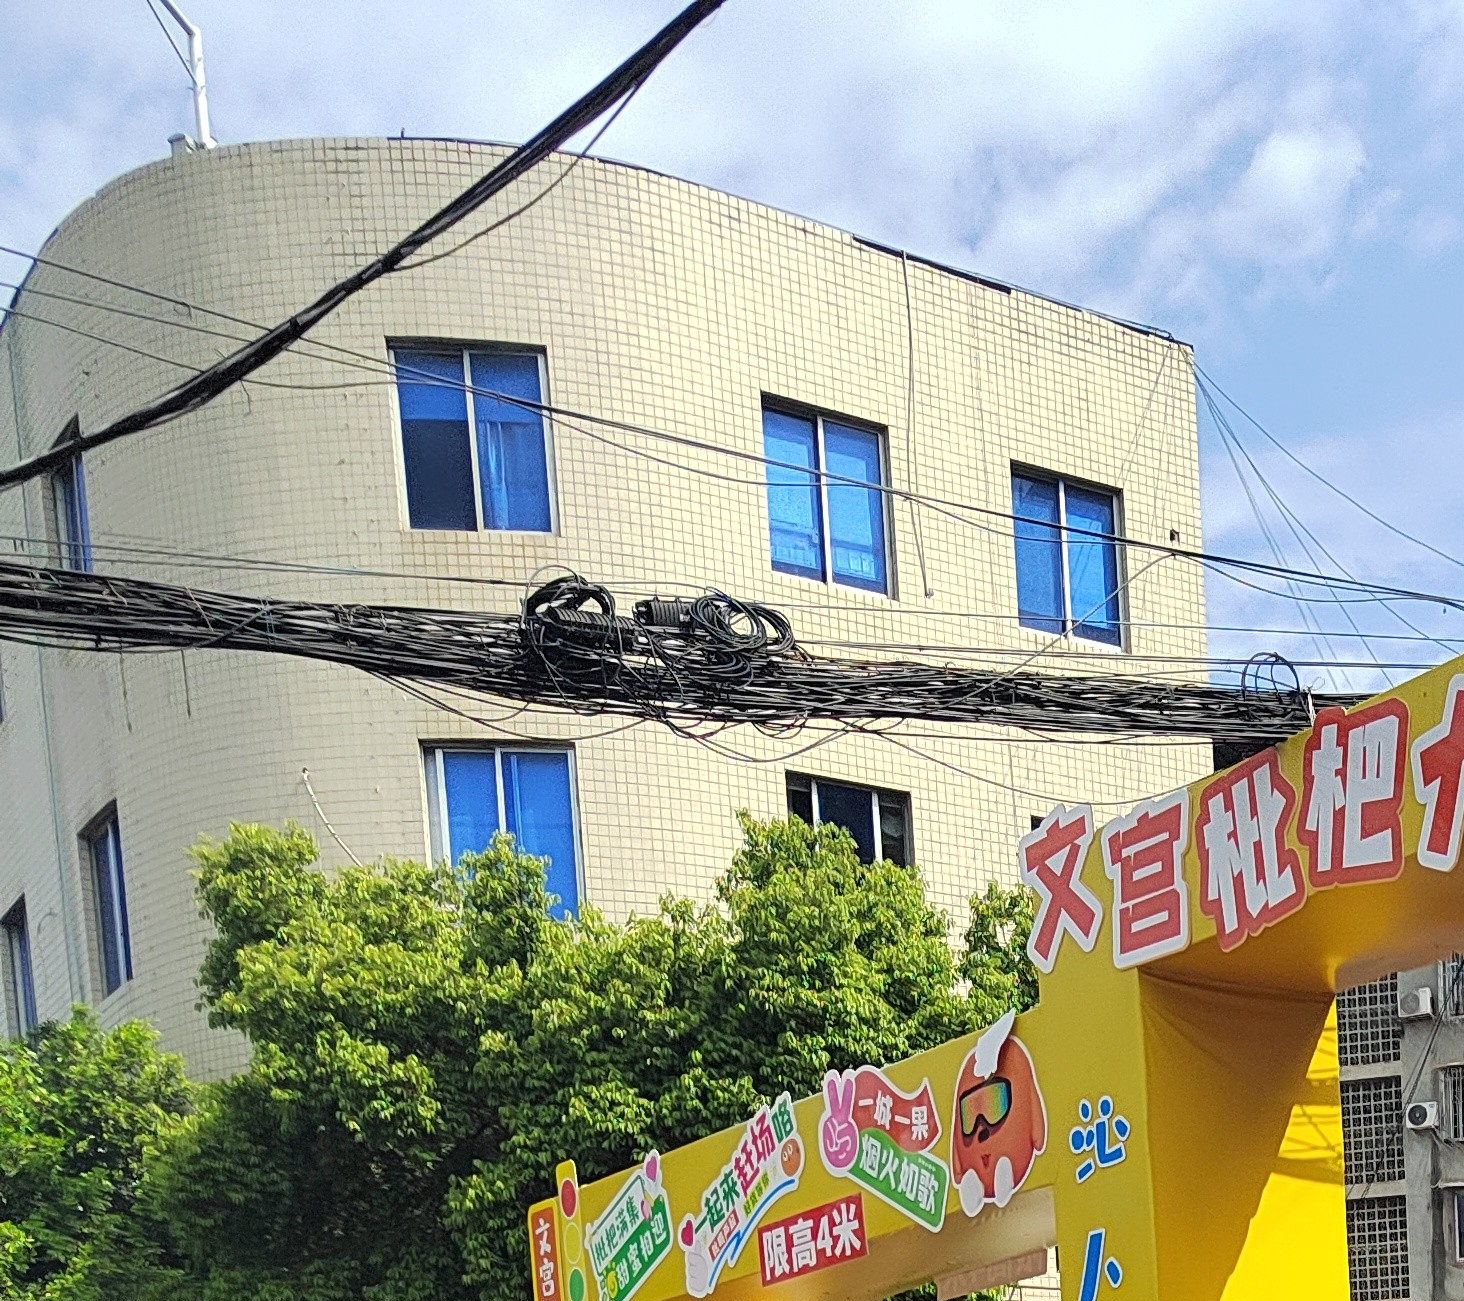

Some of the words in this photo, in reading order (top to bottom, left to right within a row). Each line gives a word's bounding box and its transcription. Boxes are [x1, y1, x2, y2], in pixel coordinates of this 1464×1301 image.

[858, 1089, 929, 1141] 一城一果
[694, 1098, 795, 1234] 一起来赶场咯
[859, 1133, 939, 1215] 烟火如歌
[615, 1211, 667, 1290] 甜蜜相迎
[762, 1202, 863, 1281] 限高4米
